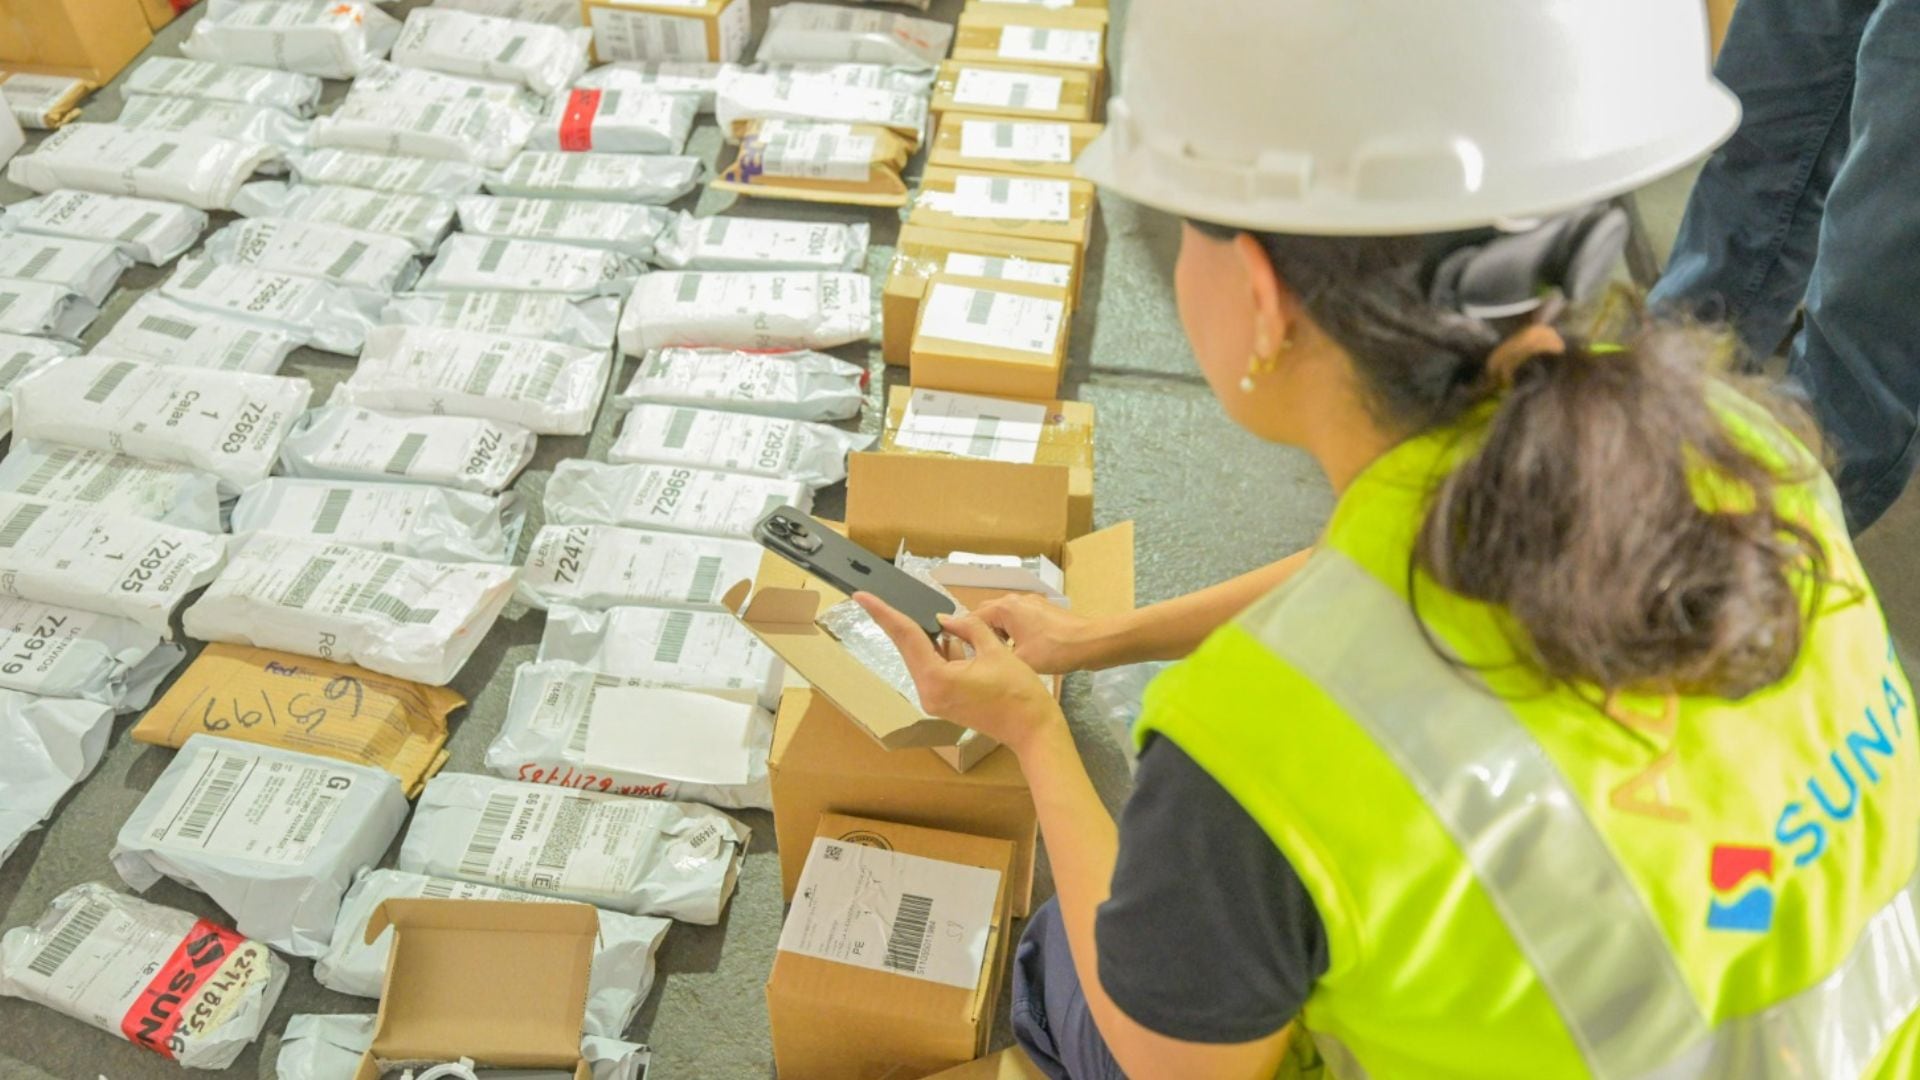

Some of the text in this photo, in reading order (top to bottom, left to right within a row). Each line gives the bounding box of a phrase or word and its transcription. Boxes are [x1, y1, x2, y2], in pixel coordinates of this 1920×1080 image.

[200, 409, 220, 421] 1
[222, 401, 268, 454] 72663
[758, 423, 790, 469] 72950
[651, 467, 691, 518] 72965
[104, 551, 124, 561] 1
[121, 539, 182, 594] 72925
[553, 525, 591, 585] 72472
[1, 614, 68, 675] 72919
[36, 626, 82, 673] U-ENVIOS
[1775, 633, 1908, 868] SUNA
[326, 775, 352, 792] G
[136, 969, 197, 1046] SUN
